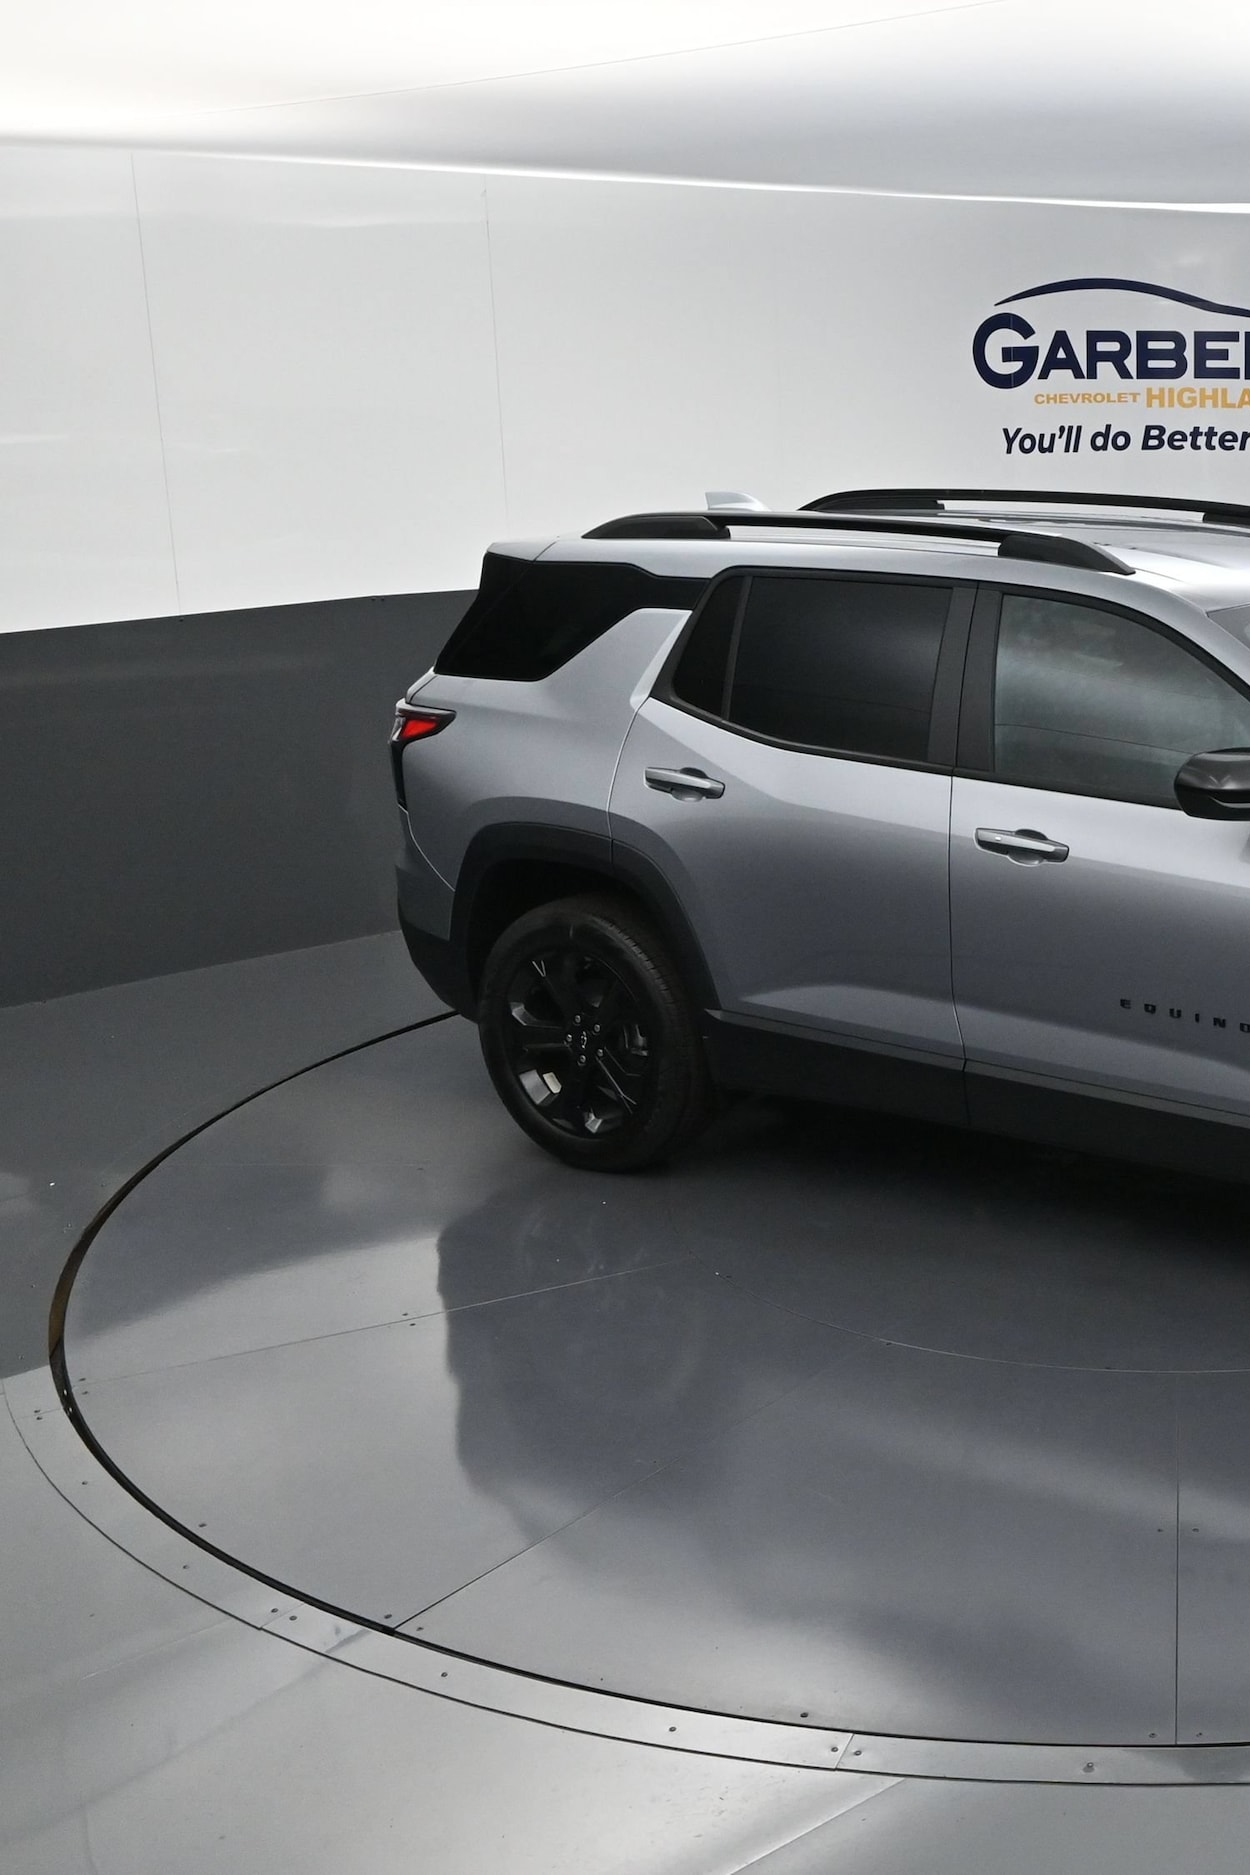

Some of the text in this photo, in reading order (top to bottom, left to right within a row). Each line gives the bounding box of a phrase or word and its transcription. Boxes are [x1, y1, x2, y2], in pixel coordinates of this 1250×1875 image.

[1033, 392, 1141, 405] CHEVROLET
[1002, 424, 1082, 455] You'll
[1090, 423, 1132, 452] do
